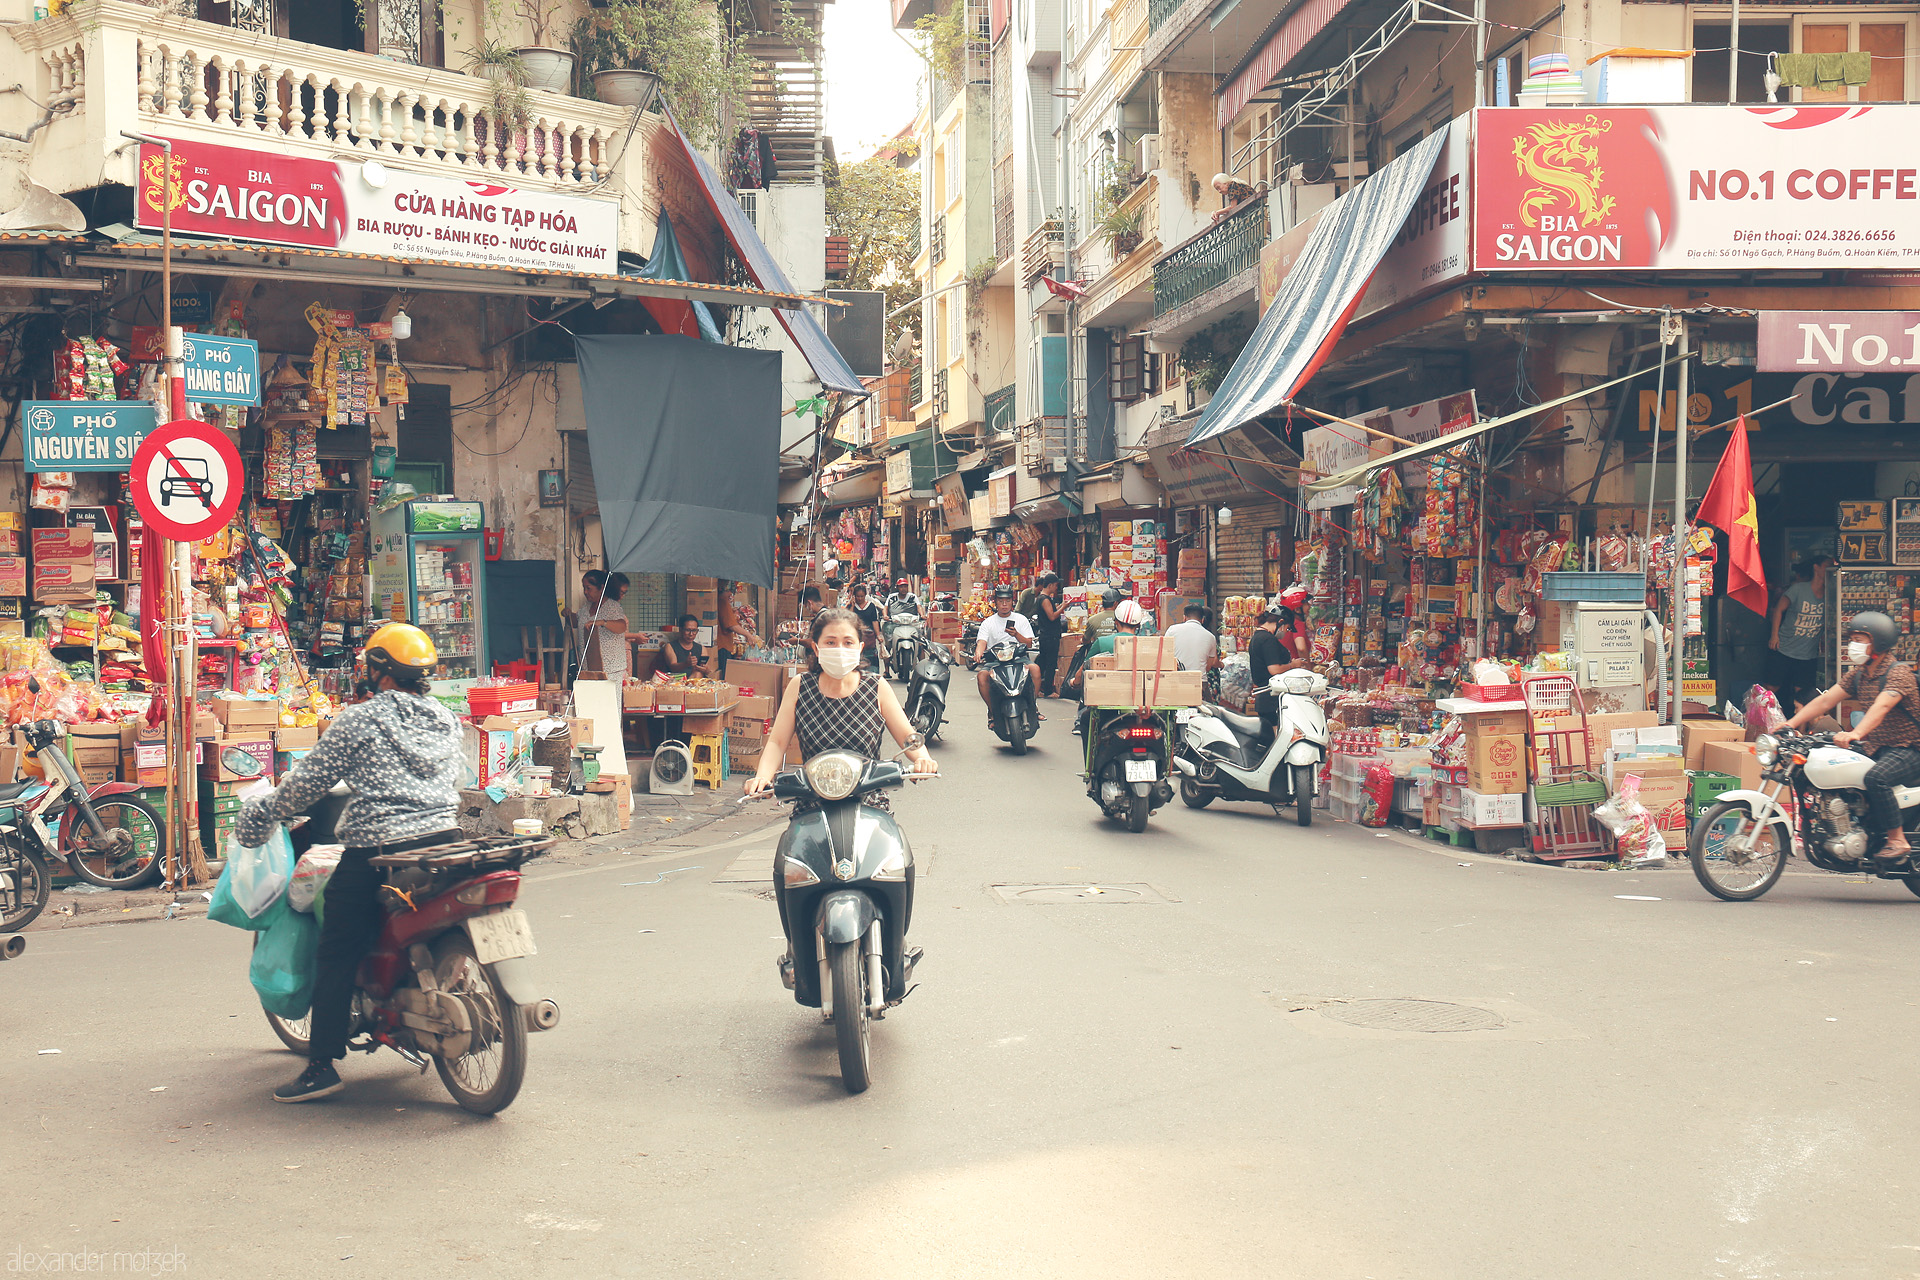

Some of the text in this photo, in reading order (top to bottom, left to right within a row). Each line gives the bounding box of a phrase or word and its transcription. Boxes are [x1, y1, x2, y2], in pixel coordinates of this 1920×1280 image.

[194, 166, 210, 175] EST.
[247, 169, 273, 184] BIA
[310, 183, 324, 191] 1875
[1689, 168, 1774, 201] NO.1
[187, 179, 328, 230] SAIGON
[394, 189, 578, 234] CỬA HÀNG TẠP HÓA
[1540, 215, 1579, 232] BIA
[357, 218, 607, 260] BIA RƯỢU BÁNH KẸO NƯỚC GIẢI KHÁT
[1733, 229, 1896, 245] Điện thoại: 024.3826.6656
[1496, 234, 1622, 261] SAIGON
[1719, 248, 1731, 258] Số
[1731, 249, 1741, 257] 01
[1786, 248, 1816, 260] P.Hàng
[205, 347, 232, 363] PHỐ
[186, 363, 252, 395] HÀNG GIẦY
[73, 411, 117, 428] PHỐ
[34, 427, 144, 459] NGUYỄN SIÊ
[480, 757, 487, 765] 6
